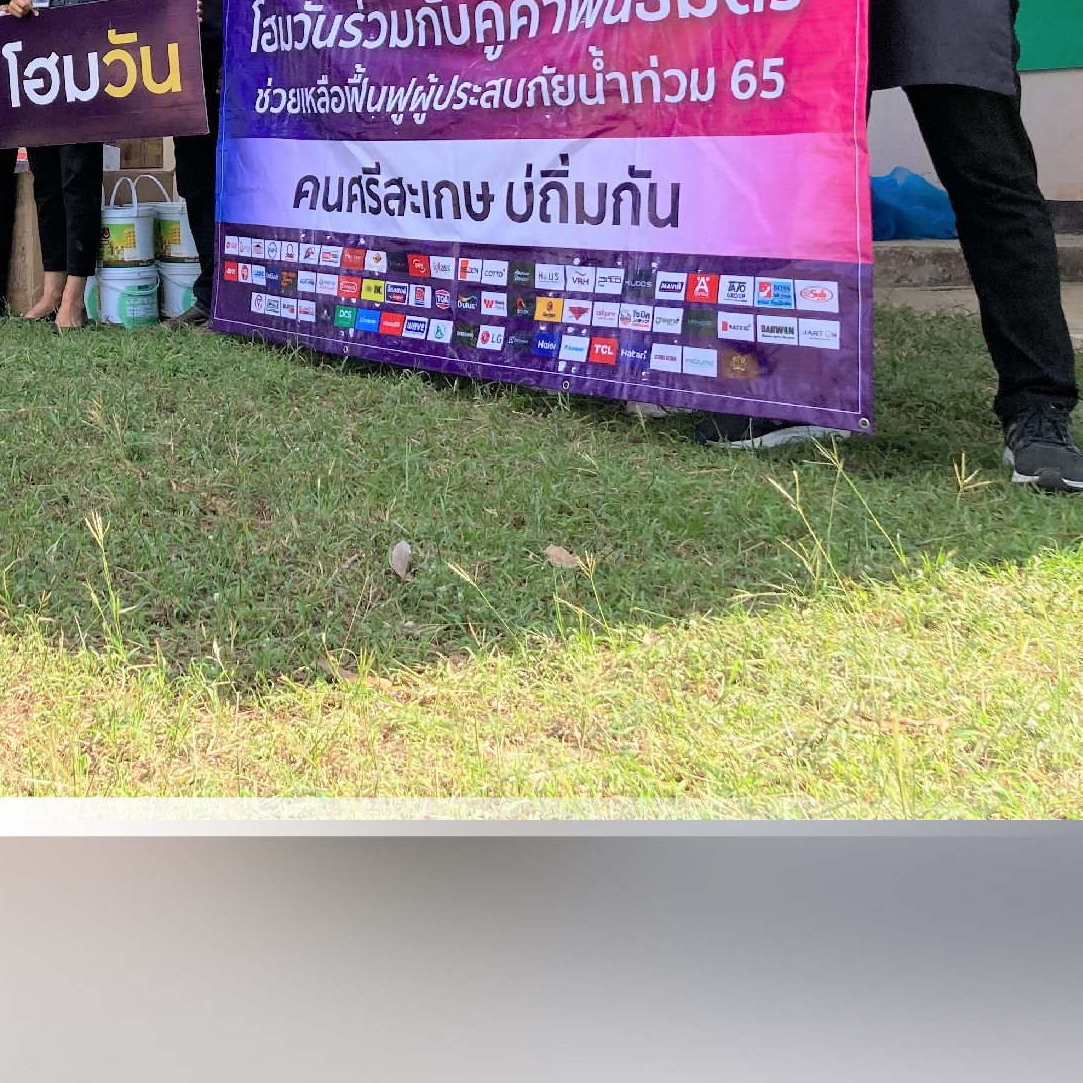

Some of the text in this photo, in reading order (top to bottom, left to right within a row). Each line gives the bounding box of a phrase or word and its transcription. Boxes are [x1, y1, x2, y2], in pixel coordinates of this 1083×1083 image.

[1, 28, 183, 108] โฮมวัน
[253, 46, 786, 126] ช่วยเหลือฟื้นฟูผู้ประสบภัยน้ำท่วม 65
[292, 153, 681, 228] คนศรีสะเกษ บ่ถิ่มกัน
[572, 277, 590, 286] VRH
[594, 343, 614, 356] TCL
[621, 348, 648, 360] Hatari
